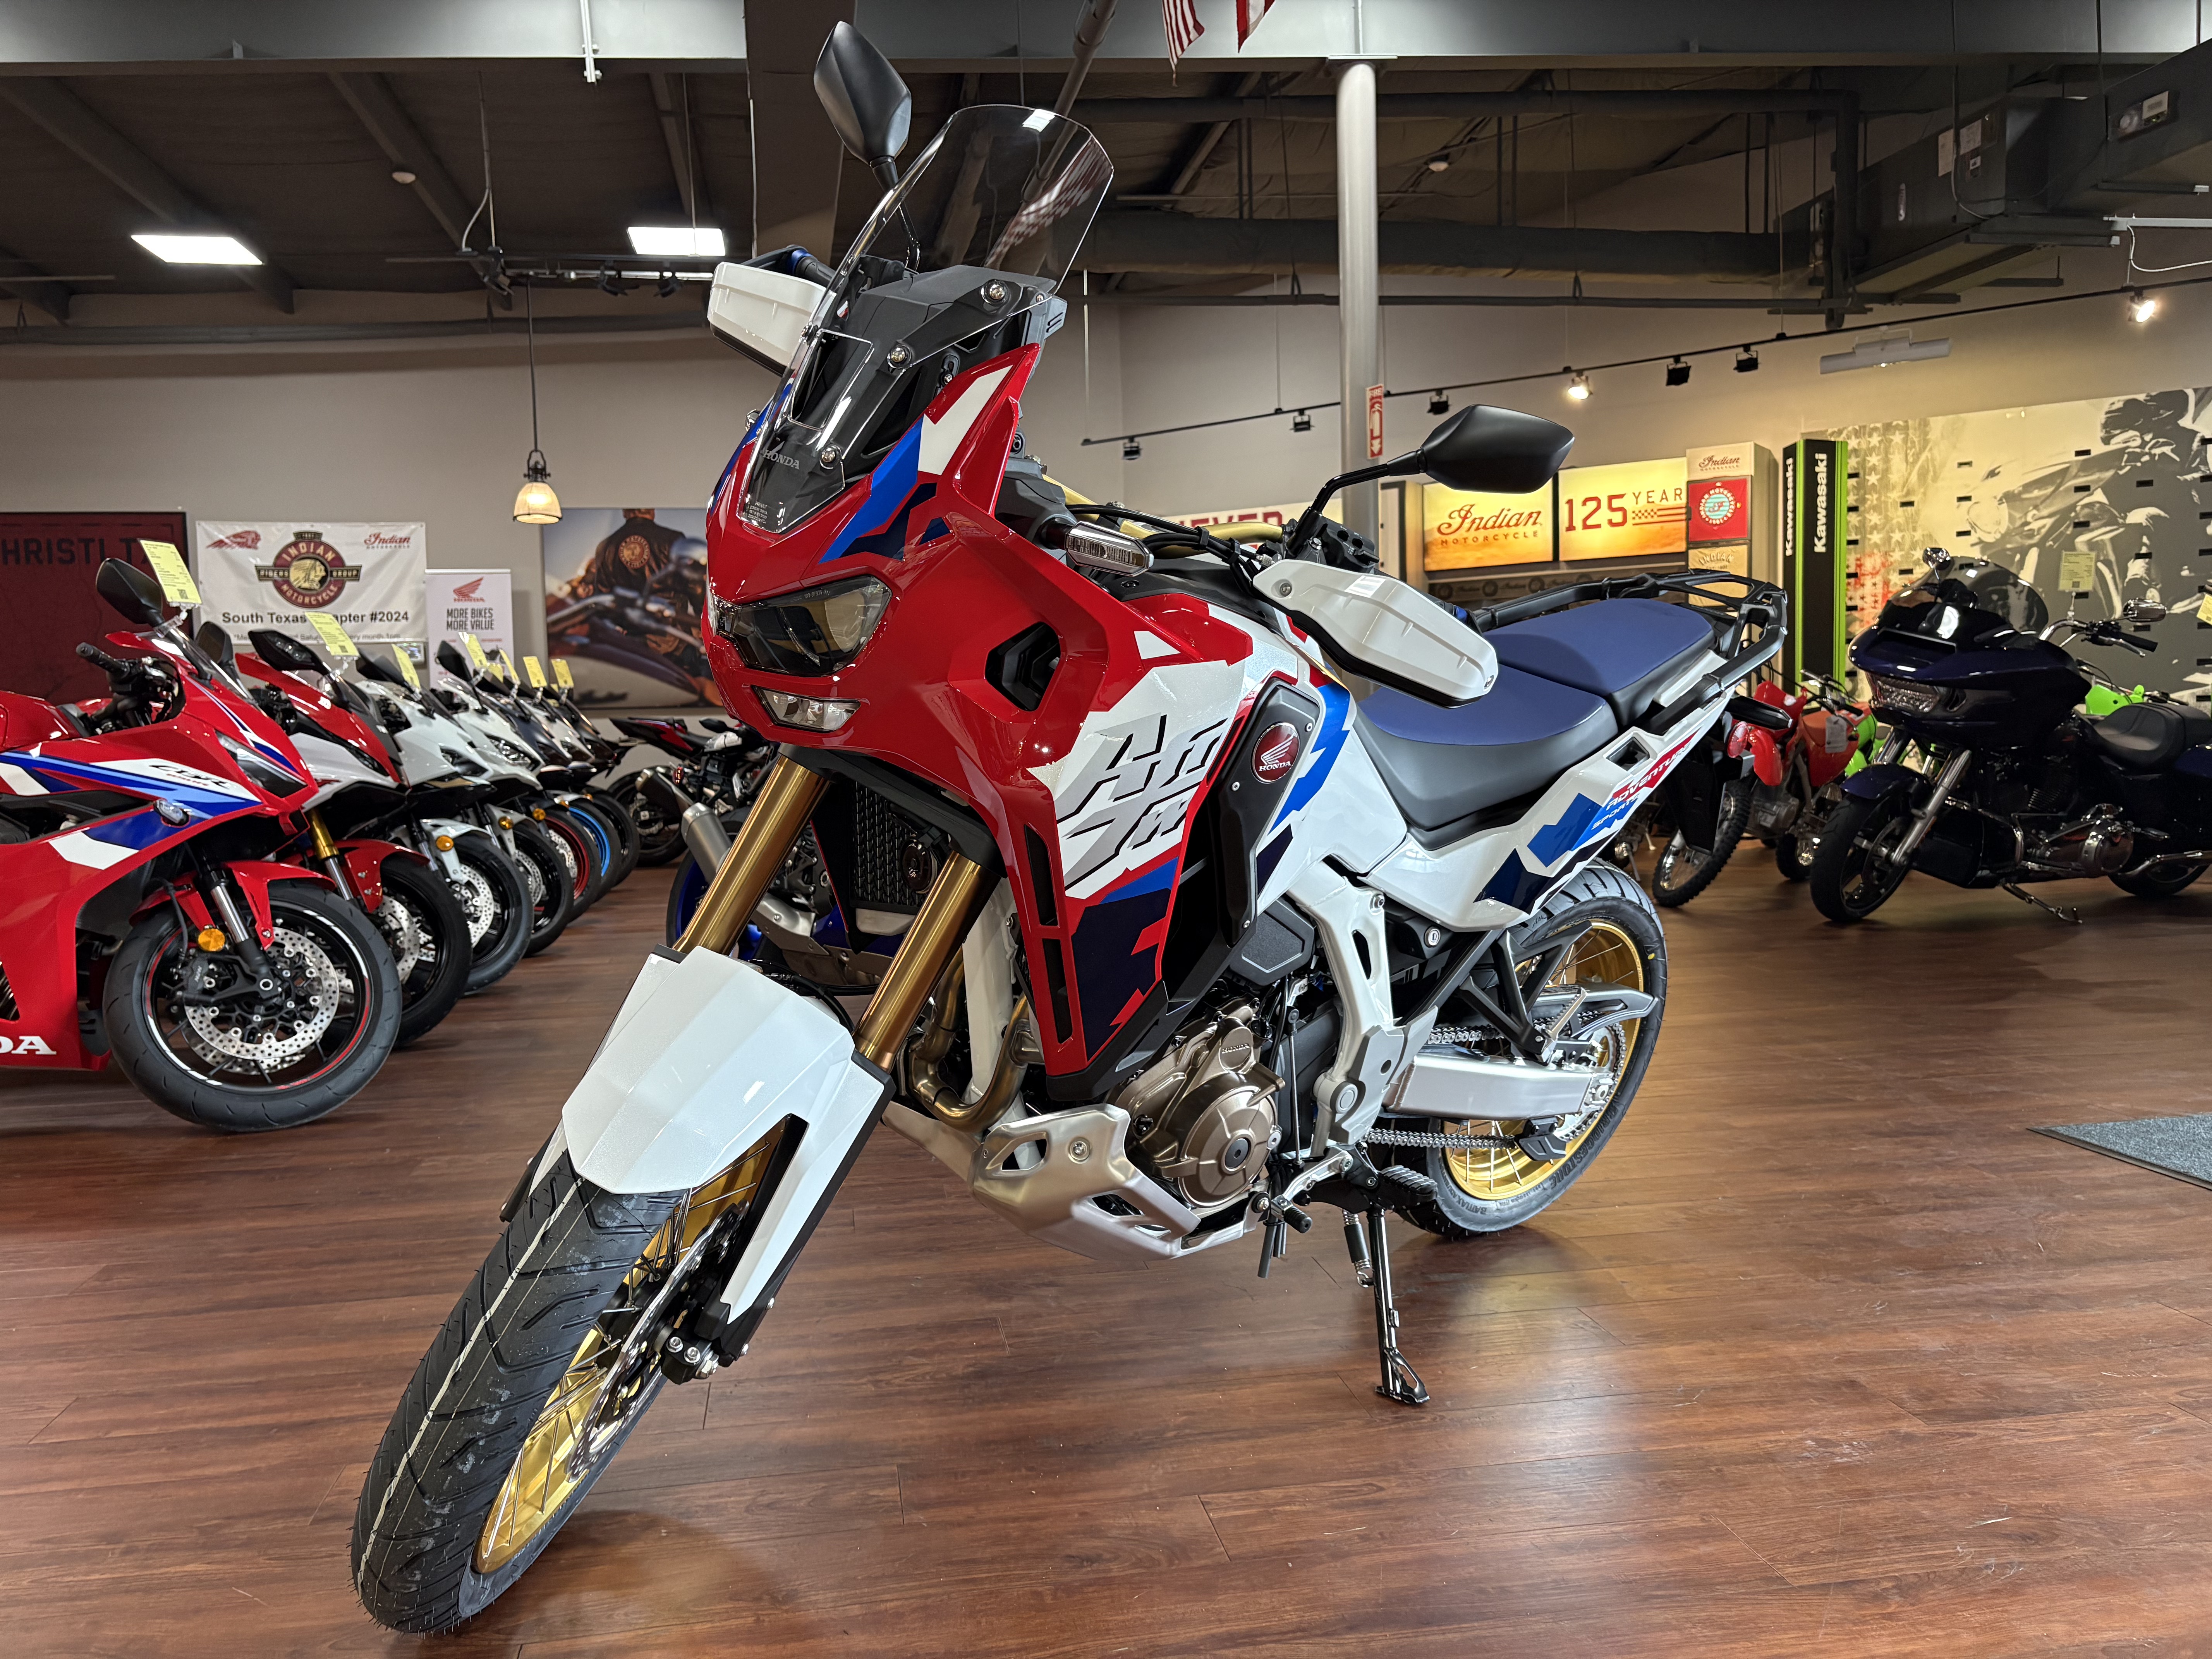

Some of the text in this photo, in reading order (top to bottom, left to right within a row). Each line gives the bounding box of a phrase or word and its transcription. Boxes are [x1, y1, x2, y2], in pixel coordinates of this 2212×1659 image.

[763, 449, 800, 470] HONDA
[1698, 455, 1740, 468] Indian
[1565, 488, 1682, 532] 125 YEAR
[1814, 453, 1827, 553] Kawasaki
[1437, 503, 1542, 536] Indian
[1441, 531, 1539, 546] MOTORCYCLE
[282, 542, 336, 562] INDIAN
[281, 584, 338, 605] MOTORCYCLE
[222, 611, 409, 624] South Texas apter #2024
[447, 607, 493, 619] MORE BIKES
[447, 619, 495, 631] MORE VALUE
[1259, 761, 1291, 771] HONDA
[1606, 742, 1690, 811] ADVENTURE
[1591, 793, 1640, 830] SPORTS
[1221, 1043, 1250, 1054] HONDA
